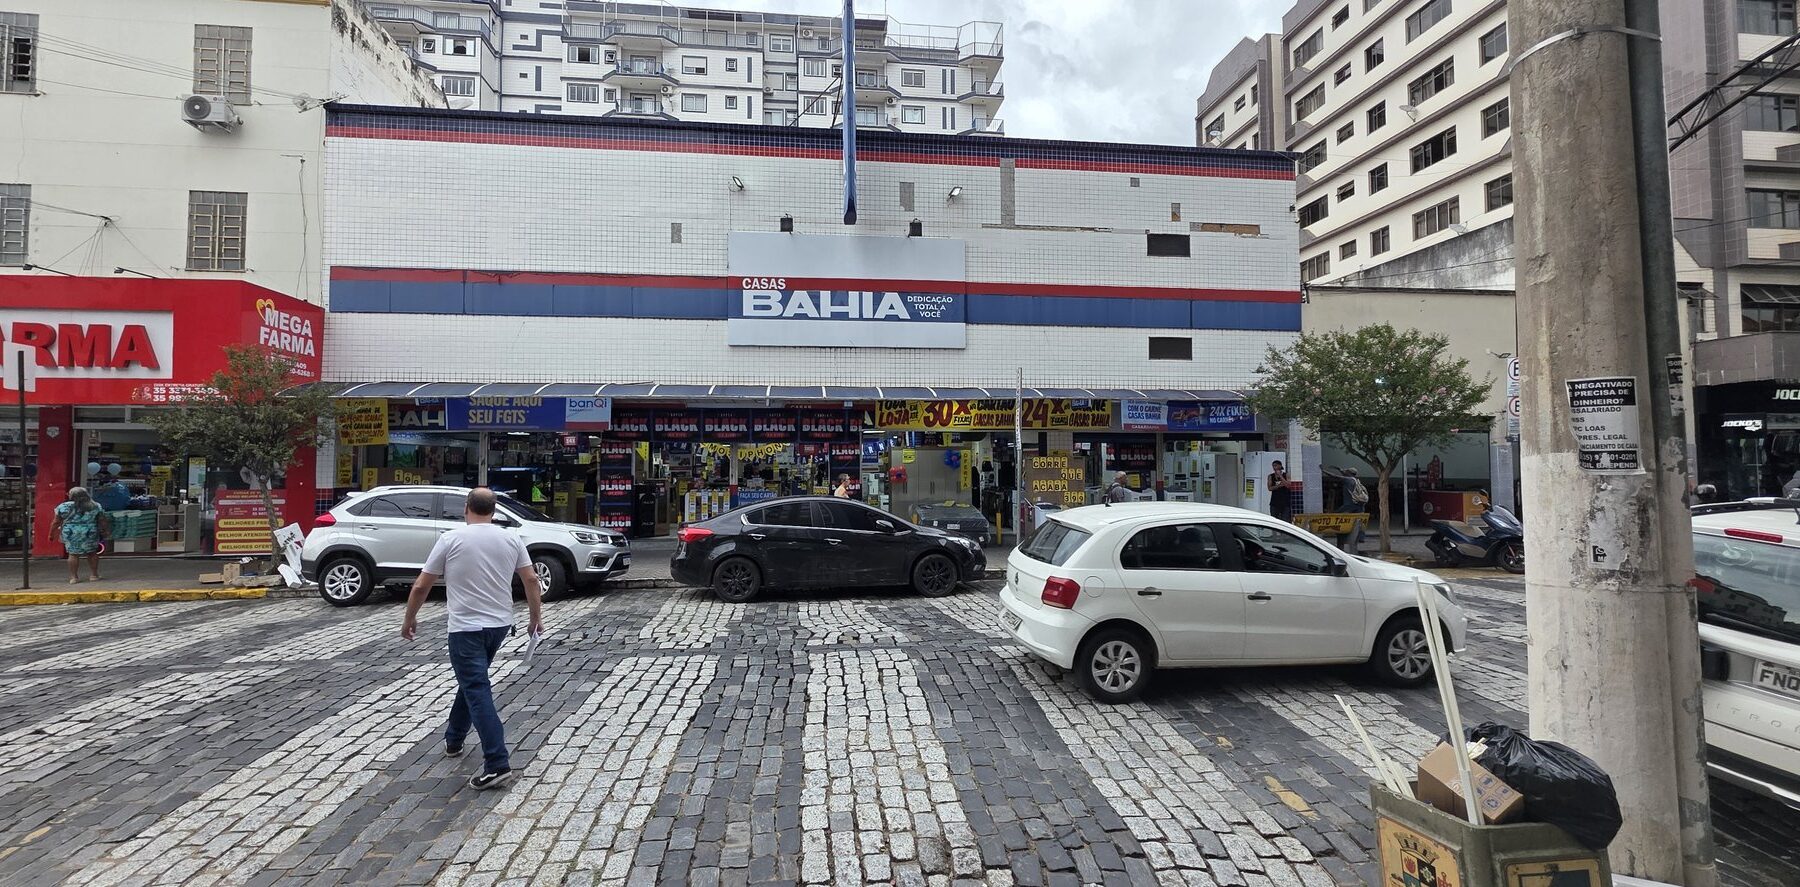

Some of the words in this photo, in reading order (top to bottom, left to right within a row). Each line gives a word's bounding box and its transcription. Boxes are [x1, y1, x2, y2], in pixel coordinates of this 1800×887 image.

[742, 277, 786, 290] CASAS
[742, 290, 911, 319] BAHIA
[907, 295, 953, 304] DEDICAÇÃO
[920, 310, 941, 318] VOCÊ
[265, 307, 312, 337] MEGA
[0, 322, 160, 369] RMA
[259, 326, 315, 357] FARMA
[1575, 381, 1632, 390] NEGATIVADO
[1772, 389, 1800, 400] JOC
[469, 396, 510, 407] SAQUE
[512, 396, 543, 407] AQUI
[569, 397, 607, 408] banQi
[1573, 398, 1624, 406] DINHEIRO?
[468, 410, 493, 424] SEU
[495, 410, 527, 424] FGTS
[1127, 412, 1144, 420] CASAS
[1210, 406, 1225, 417] 24X
[1226, 405, 1250, 416] FIXAS
[655, 418, 698, 431] BLACK
[704, 417, 747, 432] BLACK
[754, 417, 796, 432] BLACK
[802, 417, 843, 432] BLACK
[878, 409, 910, 427] LOJA
[973, 413, 994, 427] CASAS
[1069, 413, 1090, 427] CASAS
[1091, 413, 1111, 427] BAHIA
[740, 443, 782, 459] IPHON
[1033, 460, 1067, 468] CORRE
[1061, 472, 1082, 480] QUE
[1033, 483, 1067, 491] ACABA
